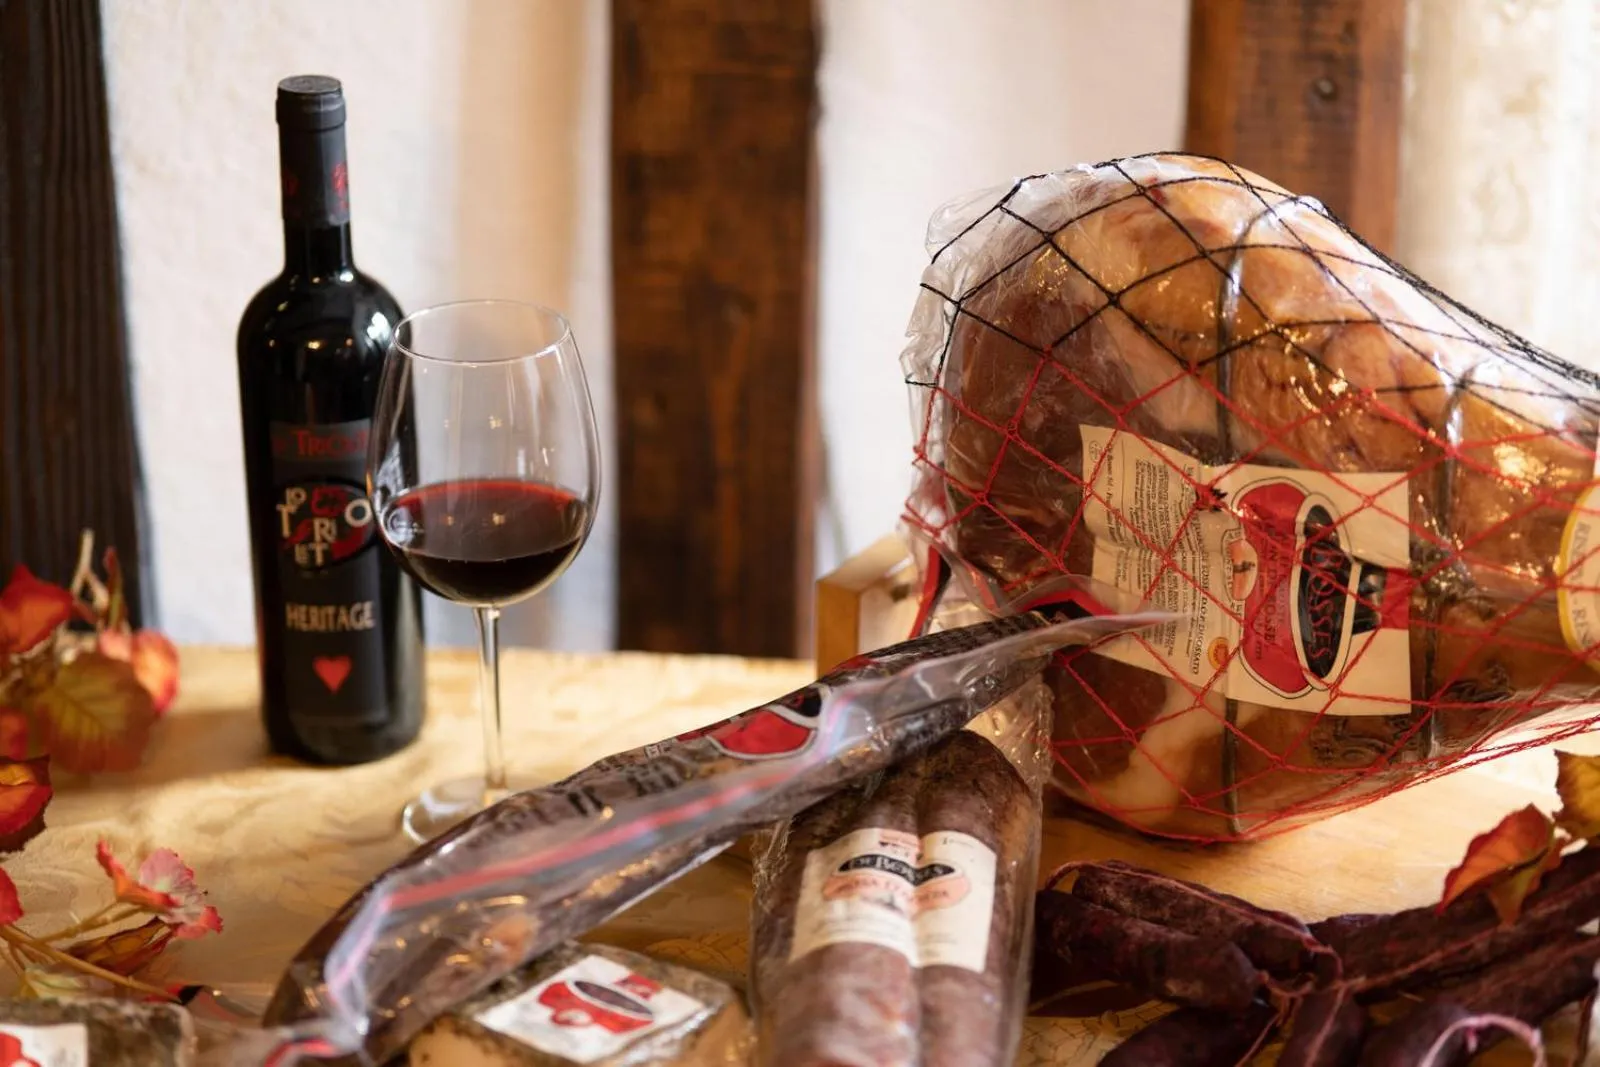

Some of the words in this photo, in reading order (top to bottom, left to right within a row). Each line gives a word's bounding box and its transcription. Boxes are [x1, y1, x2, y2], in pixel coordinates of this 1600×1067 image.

[285, 601, 377, 632] HERITAGE
[1263, 595, 1279, 643] BOSSE
[1308, 548, 1342, 660] BOSSES
[1192, 623, 1206, 675] DISOSSATO
